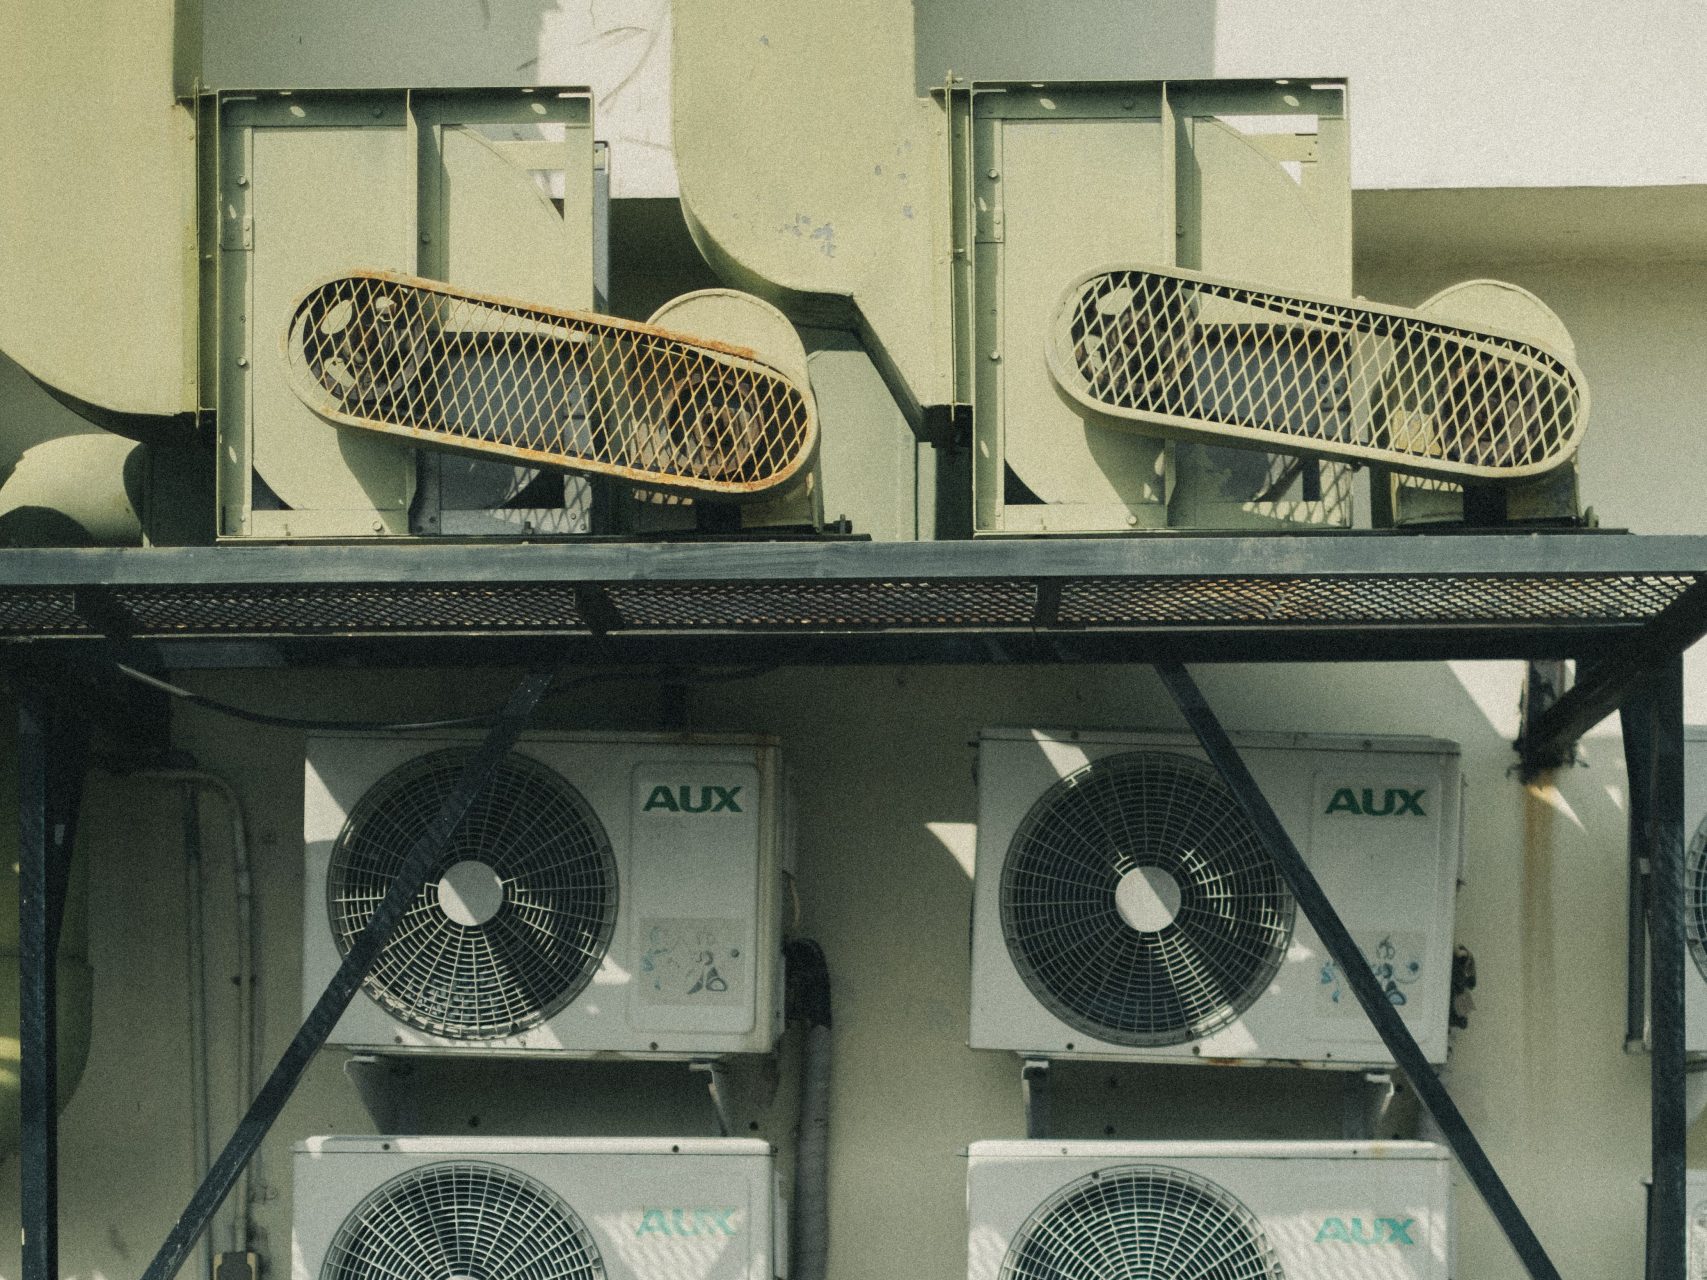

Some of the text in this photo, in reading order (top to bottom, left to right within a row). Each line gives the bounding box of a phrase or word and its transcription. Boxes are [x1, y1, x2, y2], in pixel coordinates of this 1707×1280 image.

[642, 785, 743, 813] AUX
[1325, 787, 1427, 816] AUX
[635, 1206, 737, 1236] AUX
[1313, 1217, 1415, 1245] AUX
